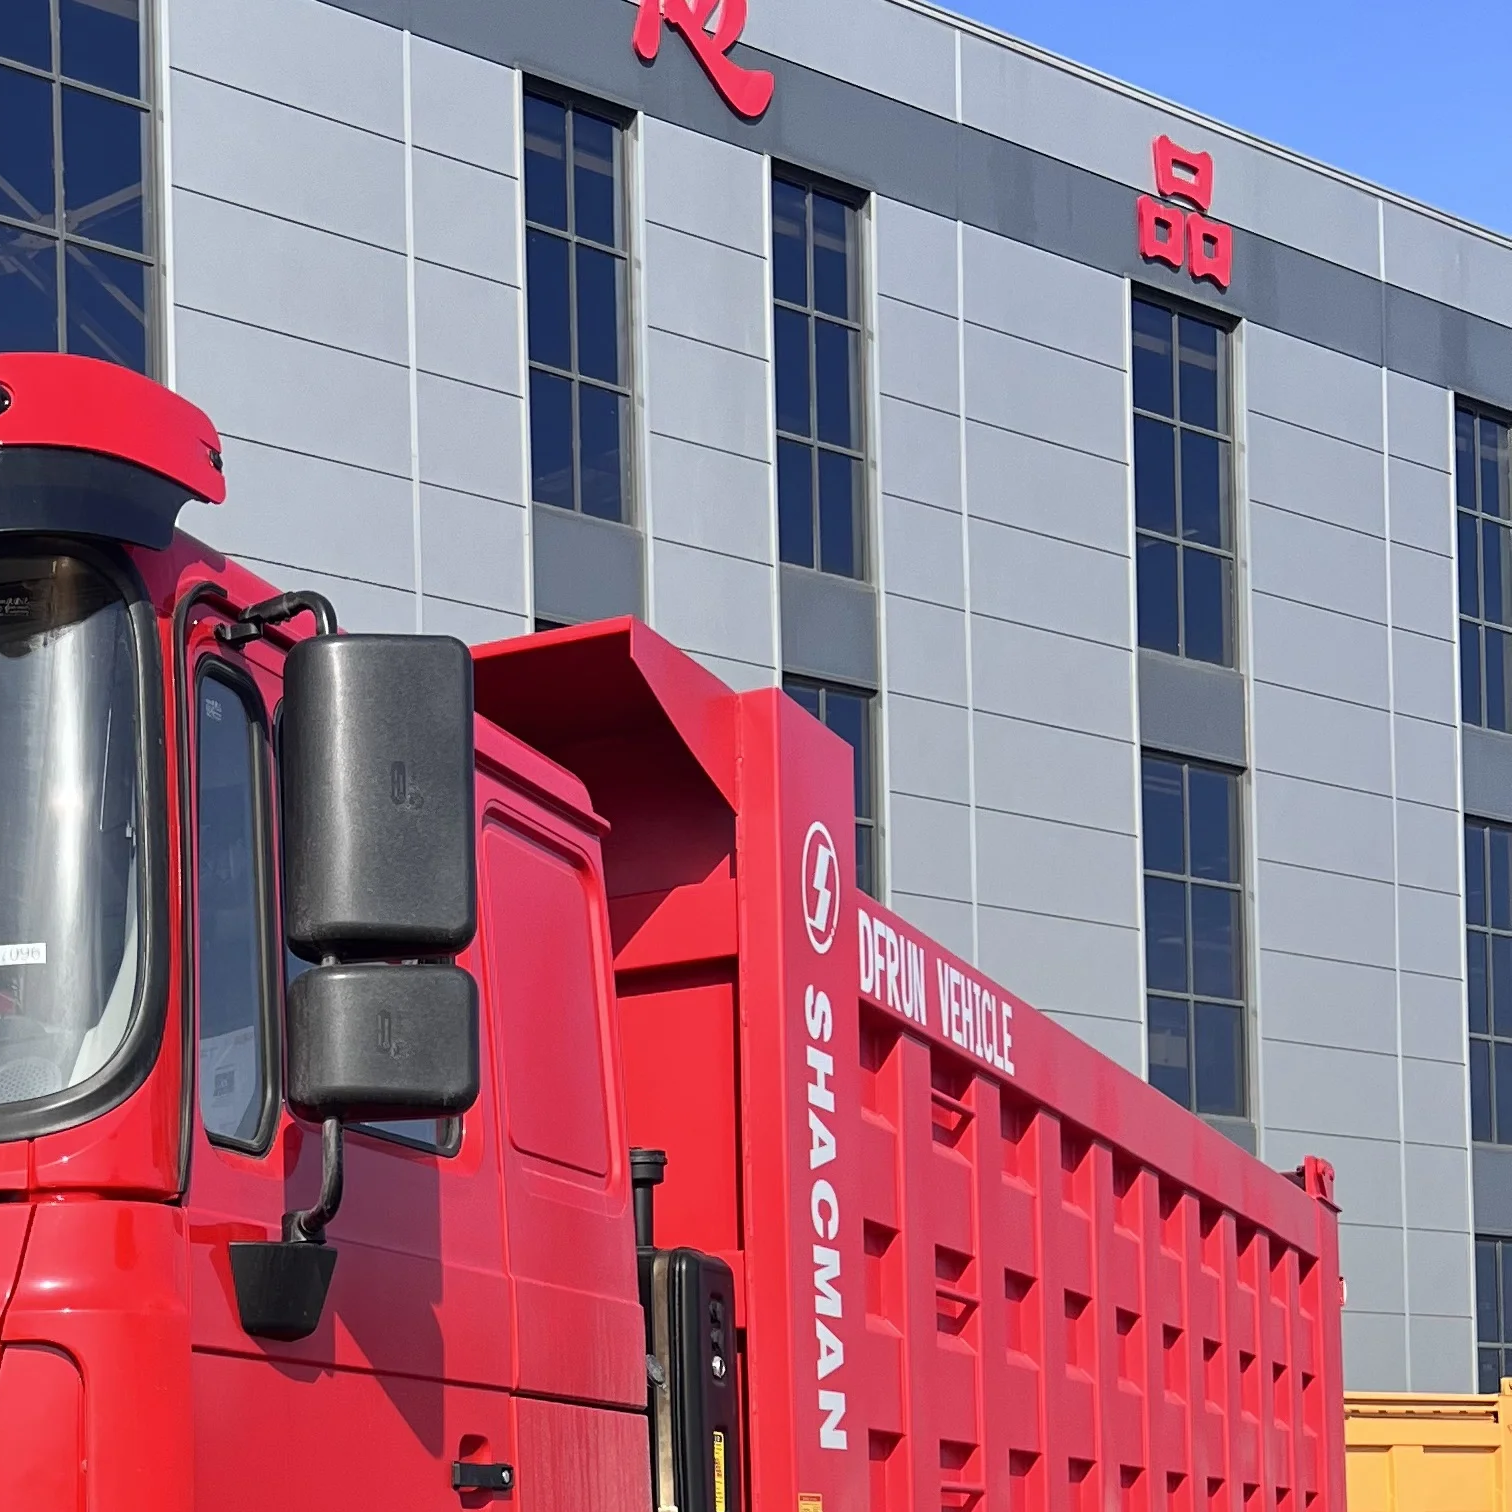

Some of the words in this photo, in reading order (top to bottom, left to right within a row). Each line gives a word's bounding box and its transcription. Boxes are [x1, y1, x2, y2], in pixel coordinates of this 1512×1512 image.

[1136, 134, 1232, 288] 品
[858, 908, 928, 1027] DFRUN
[936, 958, 1016, 1077] VEHICLE
[804, 984, 848, 1451] SHACMAN
